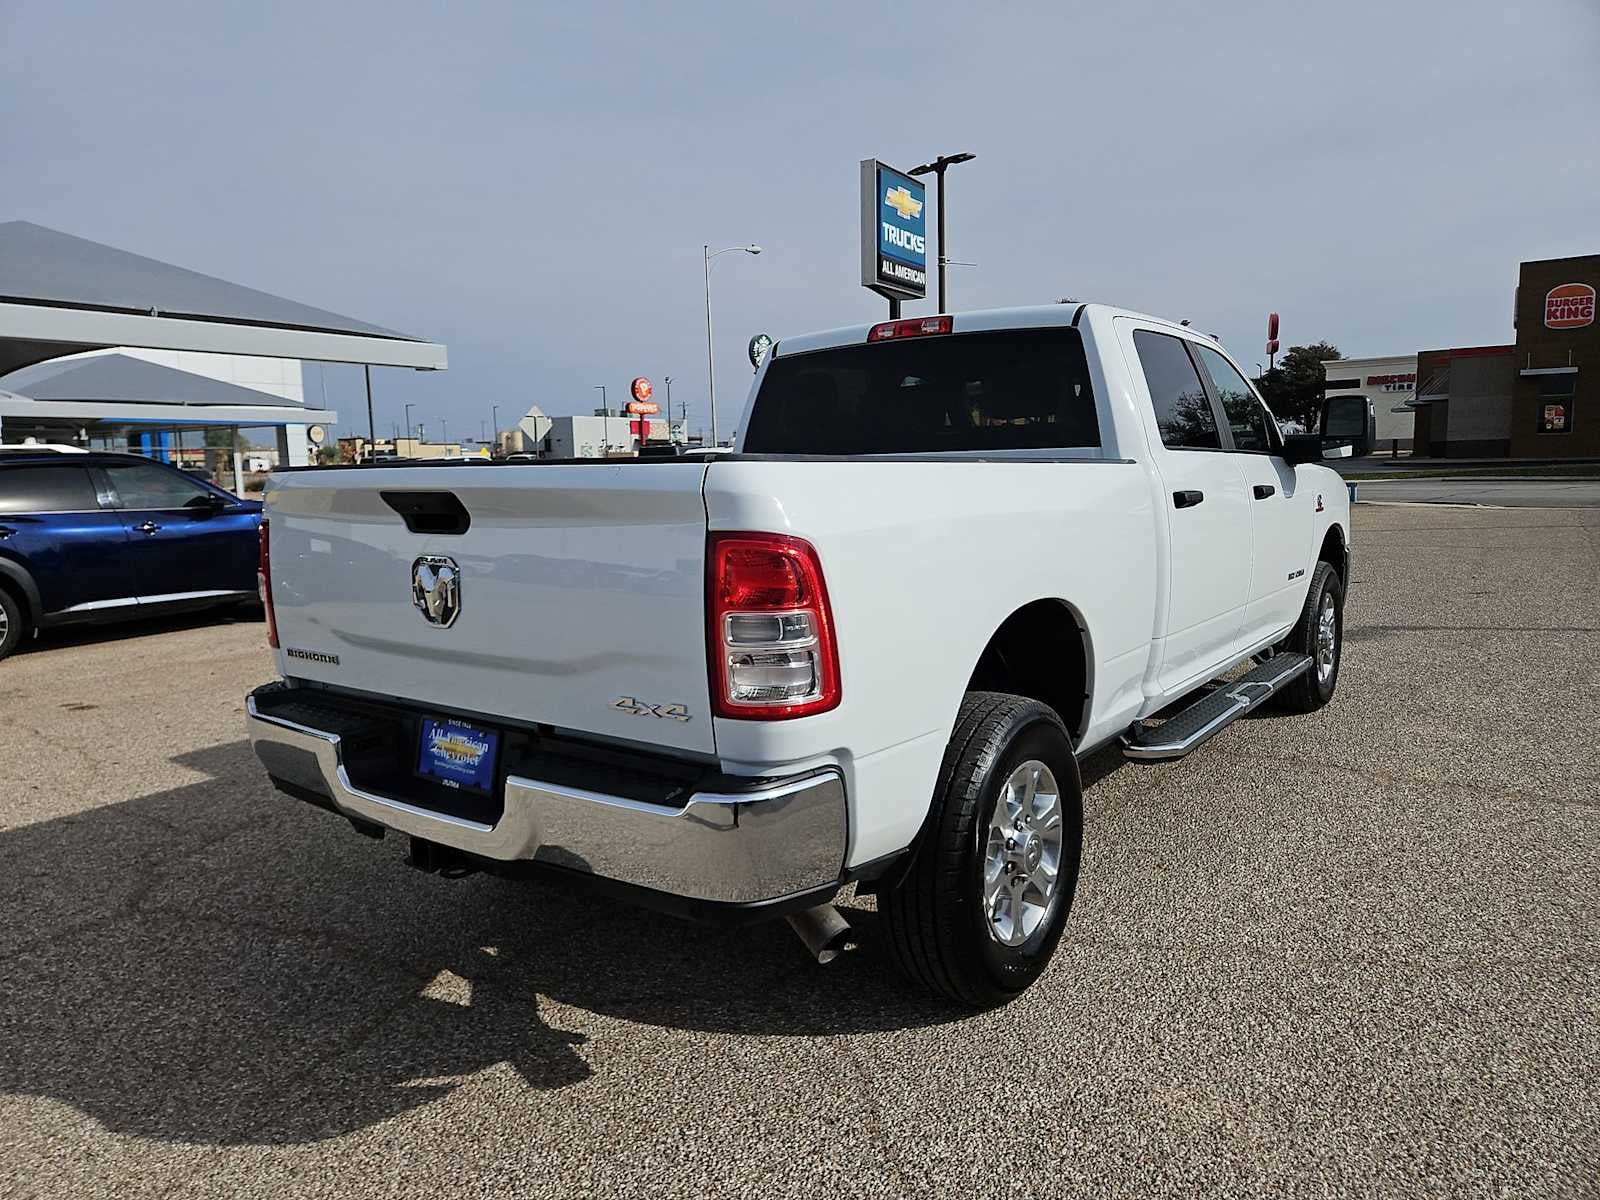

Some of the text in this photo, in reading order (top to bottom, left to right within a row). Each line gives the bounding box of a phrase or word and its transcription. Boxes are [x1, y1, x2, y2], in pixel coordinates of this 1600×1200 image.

[883, 222, 925, 254] TRUCKS
[882, 260, 925, 285] ALL AMERICAN
[1547, 296, 1594, 308] BURGER
[1547, 305, 1593, 321] KING
[428, 727, 489, 753] All American
[433, 745, 479, 767] Chevrolet
